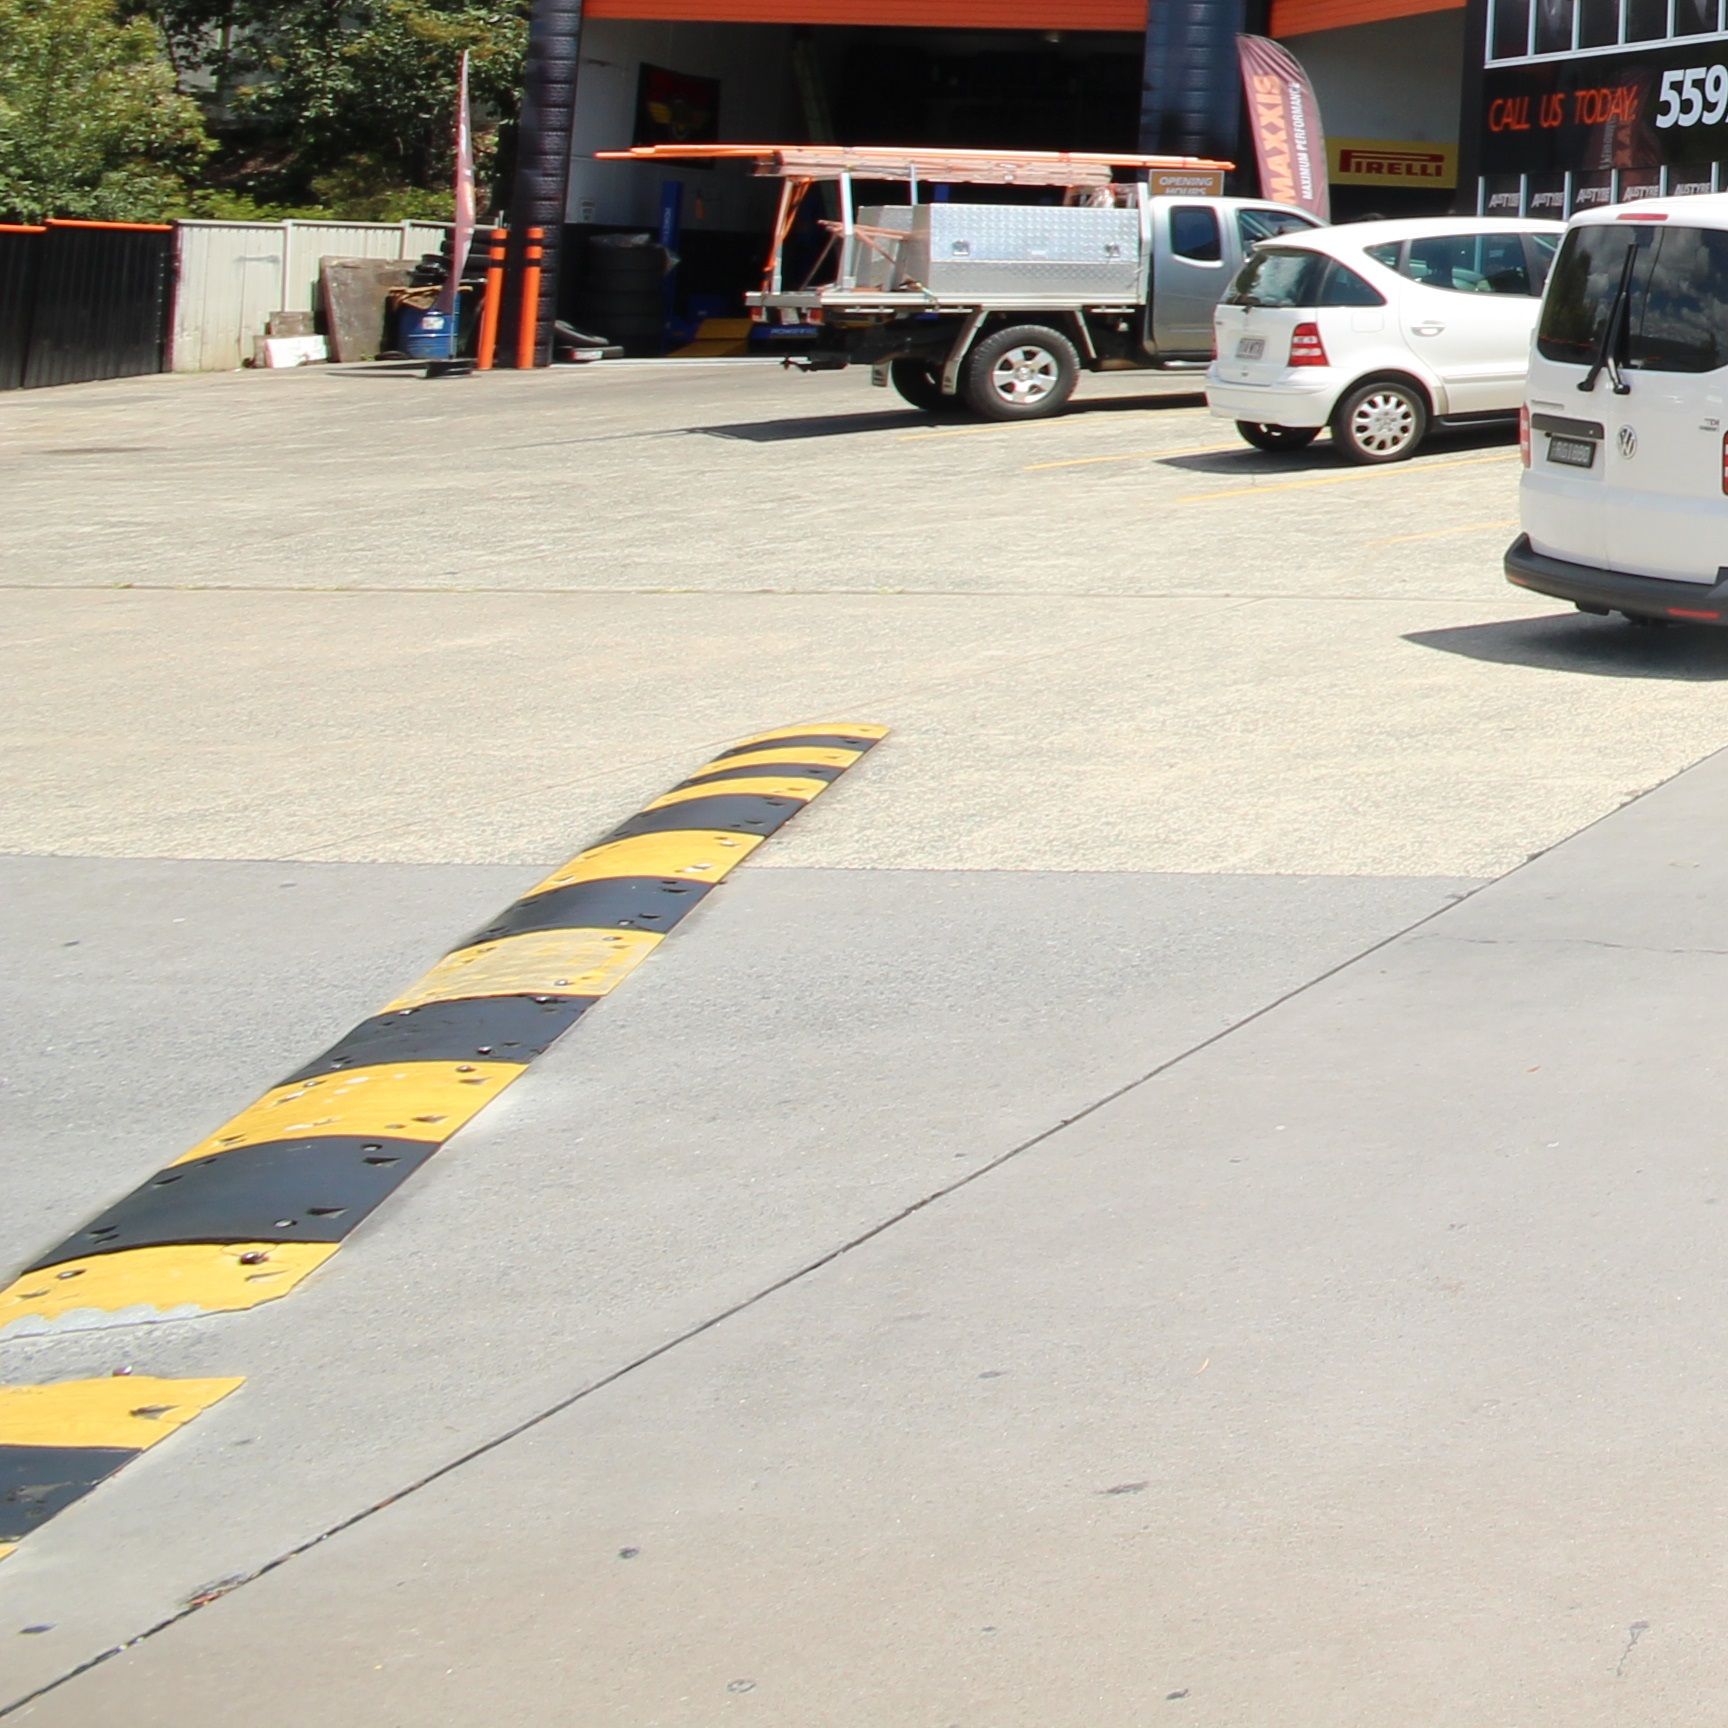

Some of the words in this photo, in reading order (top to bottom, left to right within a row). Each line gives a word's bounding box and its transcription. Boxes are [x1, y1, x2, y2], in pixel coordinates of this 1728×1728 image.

[1488, 95, 1531, 132] CALL
[1540, 92, 1566, 127] US
[1252, 73, 1298, 205] MAXXIS
[1159, 176, 1213, 186] OPENING
[1293, 152, 1313, 200] MAXIMUM
[1339, 148, 1445, 177] PIRELLI
